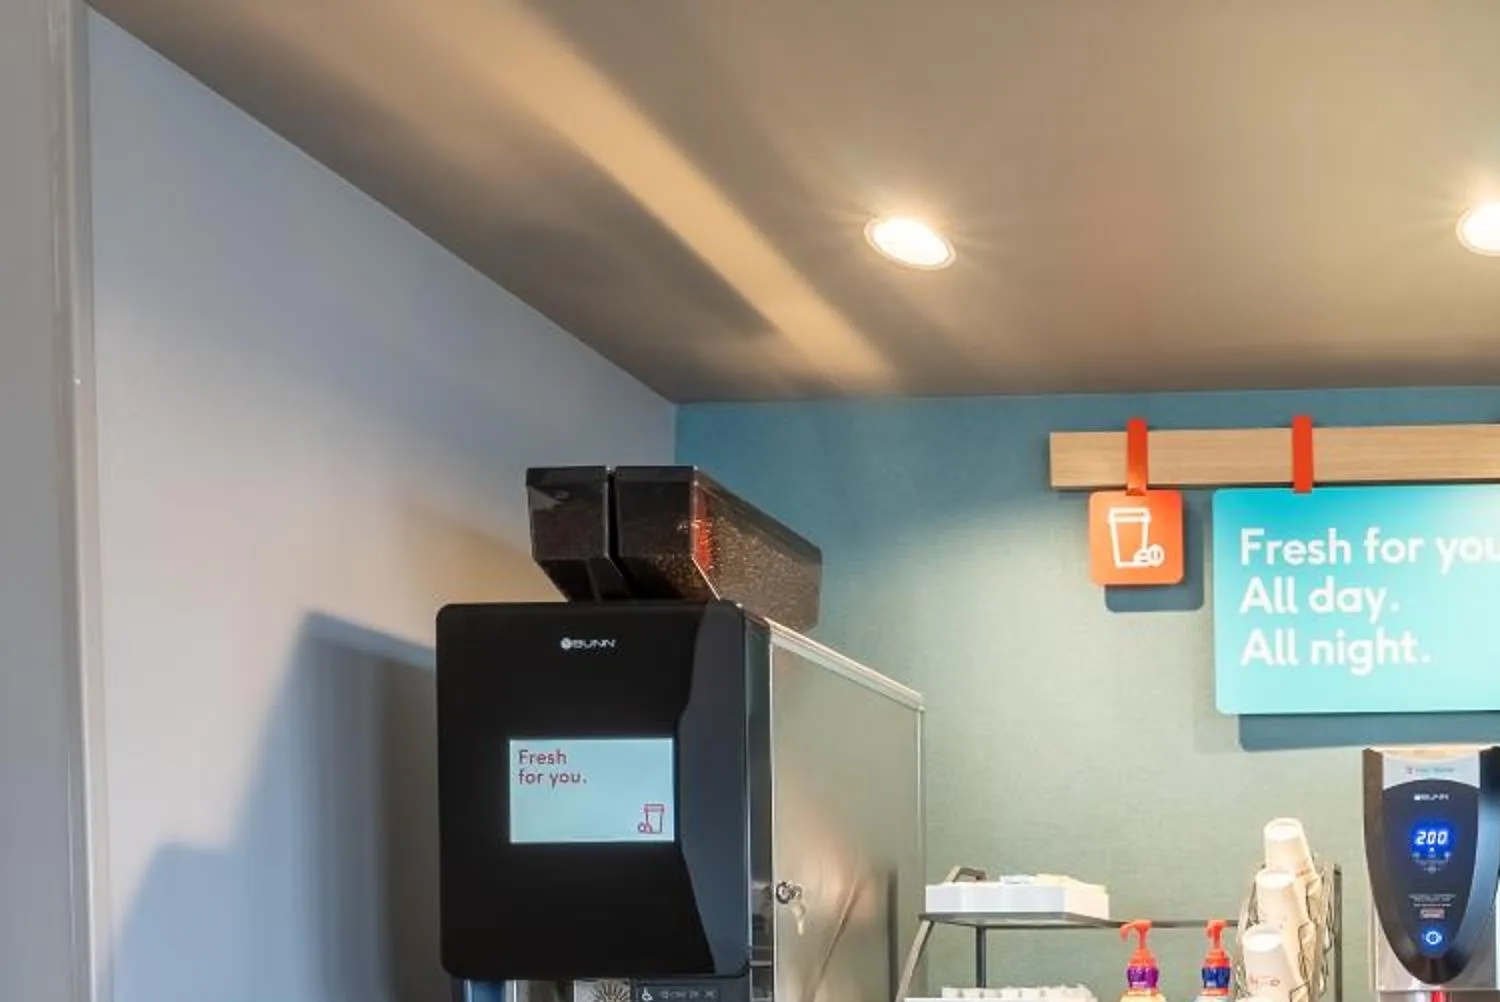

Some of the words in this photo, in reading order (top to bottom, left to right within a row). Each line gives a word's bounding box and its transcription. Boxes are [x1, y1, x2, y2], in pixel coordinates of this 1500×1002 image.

[1240, 527, 1352, 566] Fresh
[1363, 527, 1425, 565] for
[1239, 575, 1299, 614] All
[1308, 575, 1400, 624] day.
[572, 638, 616, 649] BUNN
[1239, 628, 1299, 667] All
[1309, 628, 1431, 676] night.
[518, 749, 567, 765] Fresh
[518, 769, 543, 785] for
[549, 771, 588, 789] you.
[1415, 830, 1449, 846] 200
